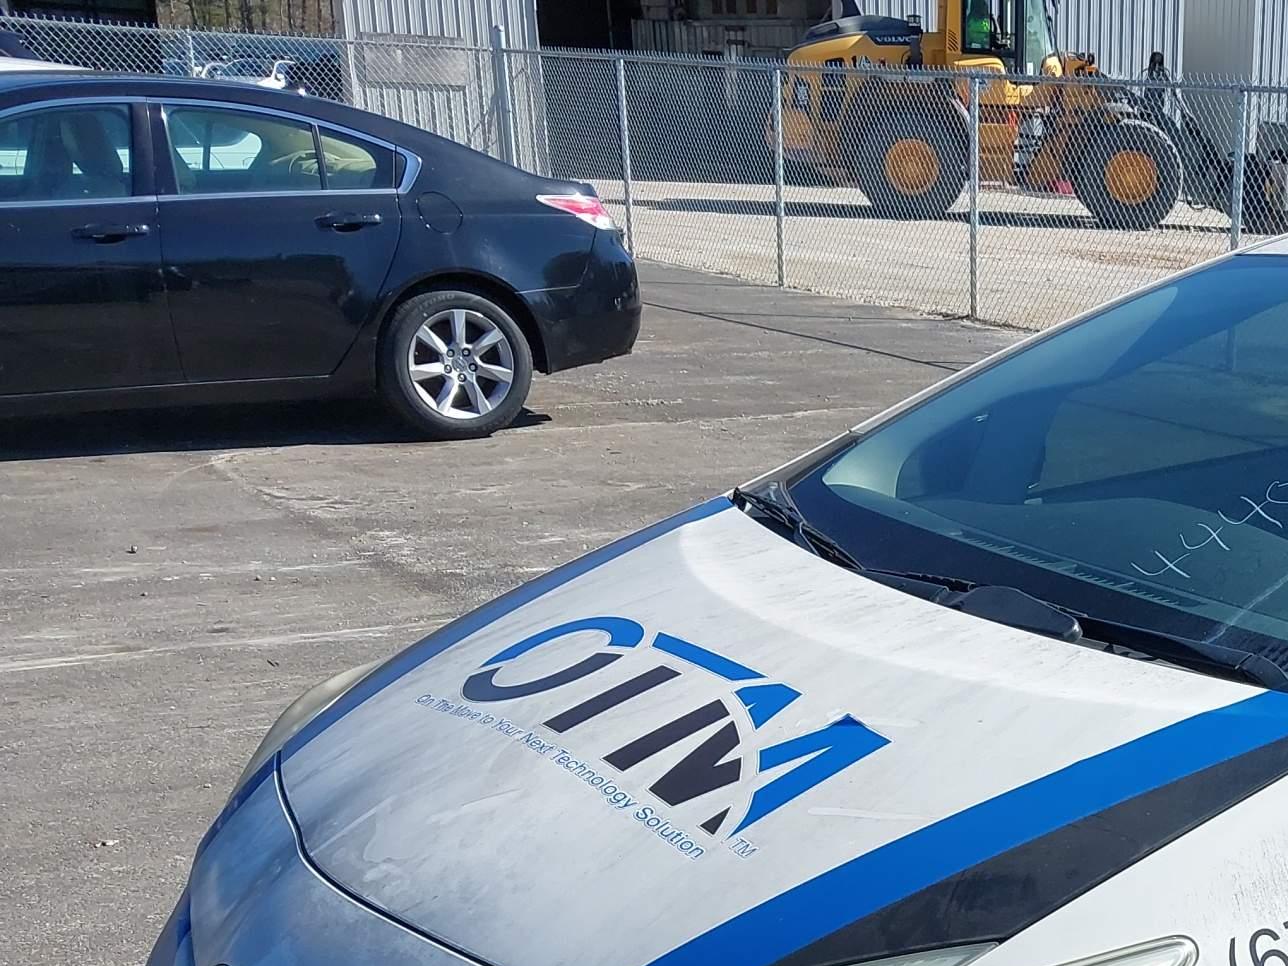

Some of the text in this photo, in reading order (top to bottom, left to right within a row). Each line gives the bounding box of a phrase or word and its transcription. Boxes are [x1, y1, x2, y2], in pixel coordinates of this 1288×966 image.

[415, 694, 706, 861] On The Move to Your Next Technology Solution
[460, 616, 893, 840] OTM
